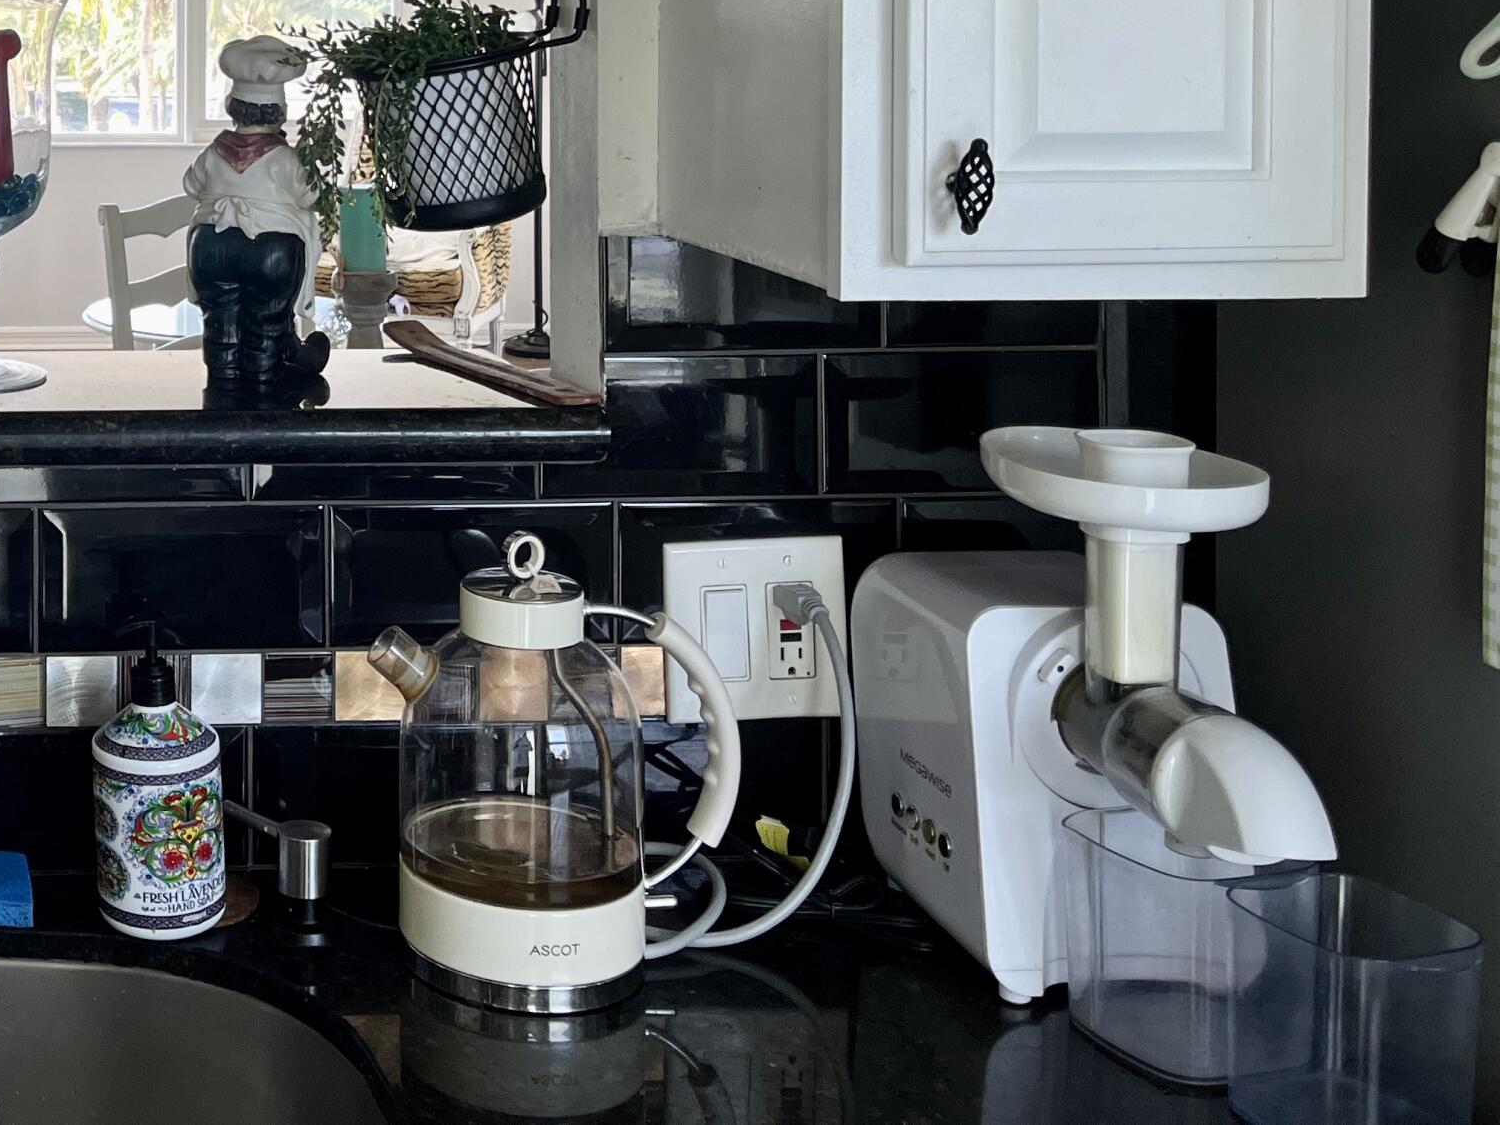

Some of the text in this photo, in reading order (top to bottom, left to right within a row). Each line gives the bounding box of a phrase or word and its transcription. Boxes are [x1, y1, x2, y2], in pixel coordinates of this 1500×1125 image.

[142, 891, 178, 904] FRESH
[167, 900, 196, 914] HAND
[528, 943, 581, 957] ASCOT
